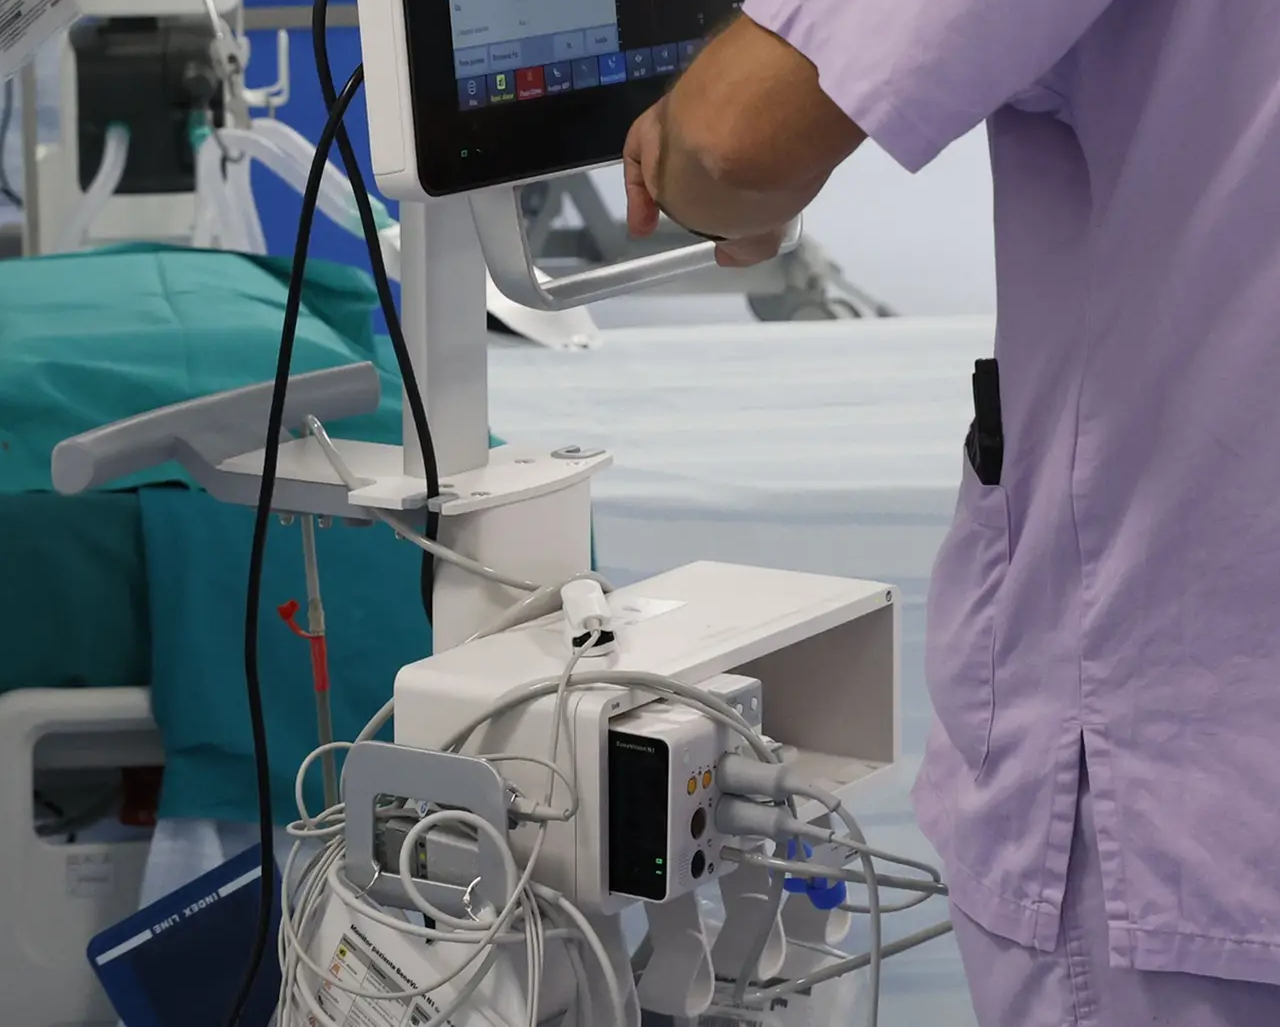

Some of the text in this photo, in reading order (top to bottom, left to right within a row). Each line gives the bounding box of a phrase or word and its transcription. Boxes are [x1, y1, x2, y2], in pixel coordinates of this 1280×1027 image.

[152, 891, 219, 934] INDEX LINE
[350, 923, 373, 948] Monitor
[371, 945, 397, 970] paziente
